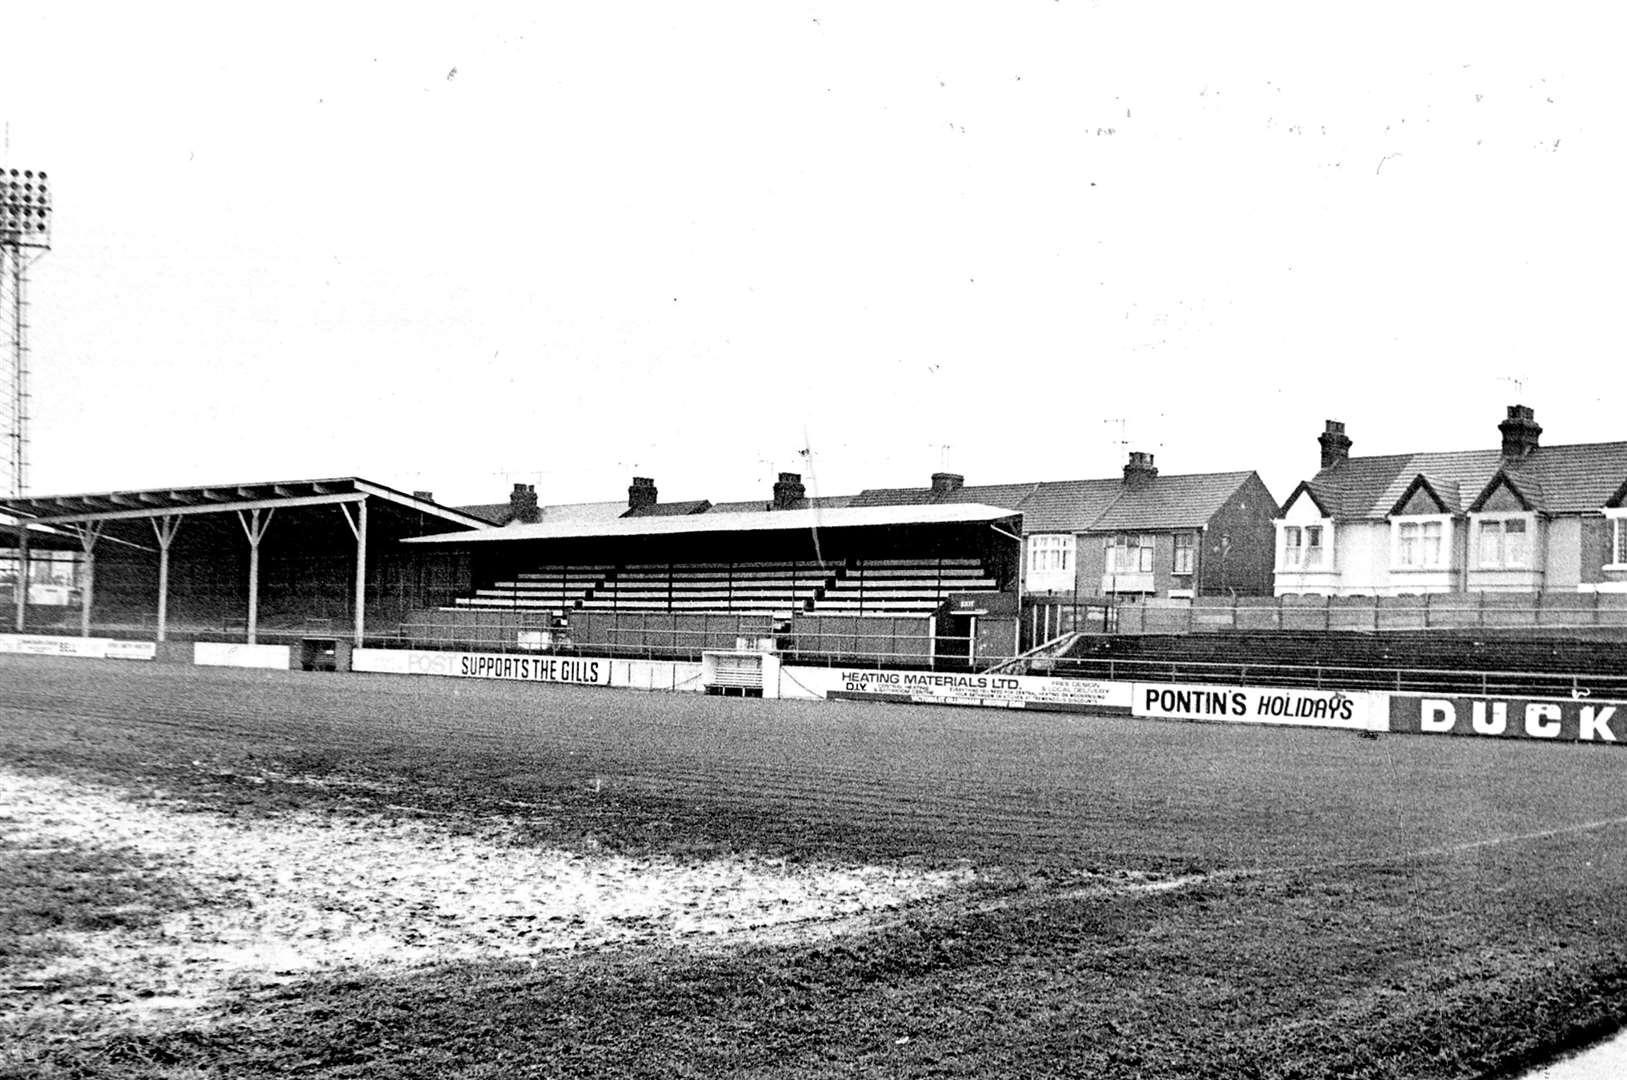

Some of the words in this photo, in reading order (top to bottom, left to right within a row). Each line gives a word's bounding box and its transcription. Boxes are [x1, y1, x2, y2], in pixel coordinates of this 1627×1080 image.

[461, 656, 529, 679] SUPPORTS
[532, 659, 557, 680] THE
[561, 661, 599, 683] GILLS
[841, 671, 900, 684] HEATING
[903, 674, 987, 688] MATERIALS
[991, 678, 1022, 690] LTD.
[1145, 688, 1247, 716] PONTIN'S
[1257, 694, 1354, 720] HOLIDAYS
[1421, 699, 1617, 741] DUCK
